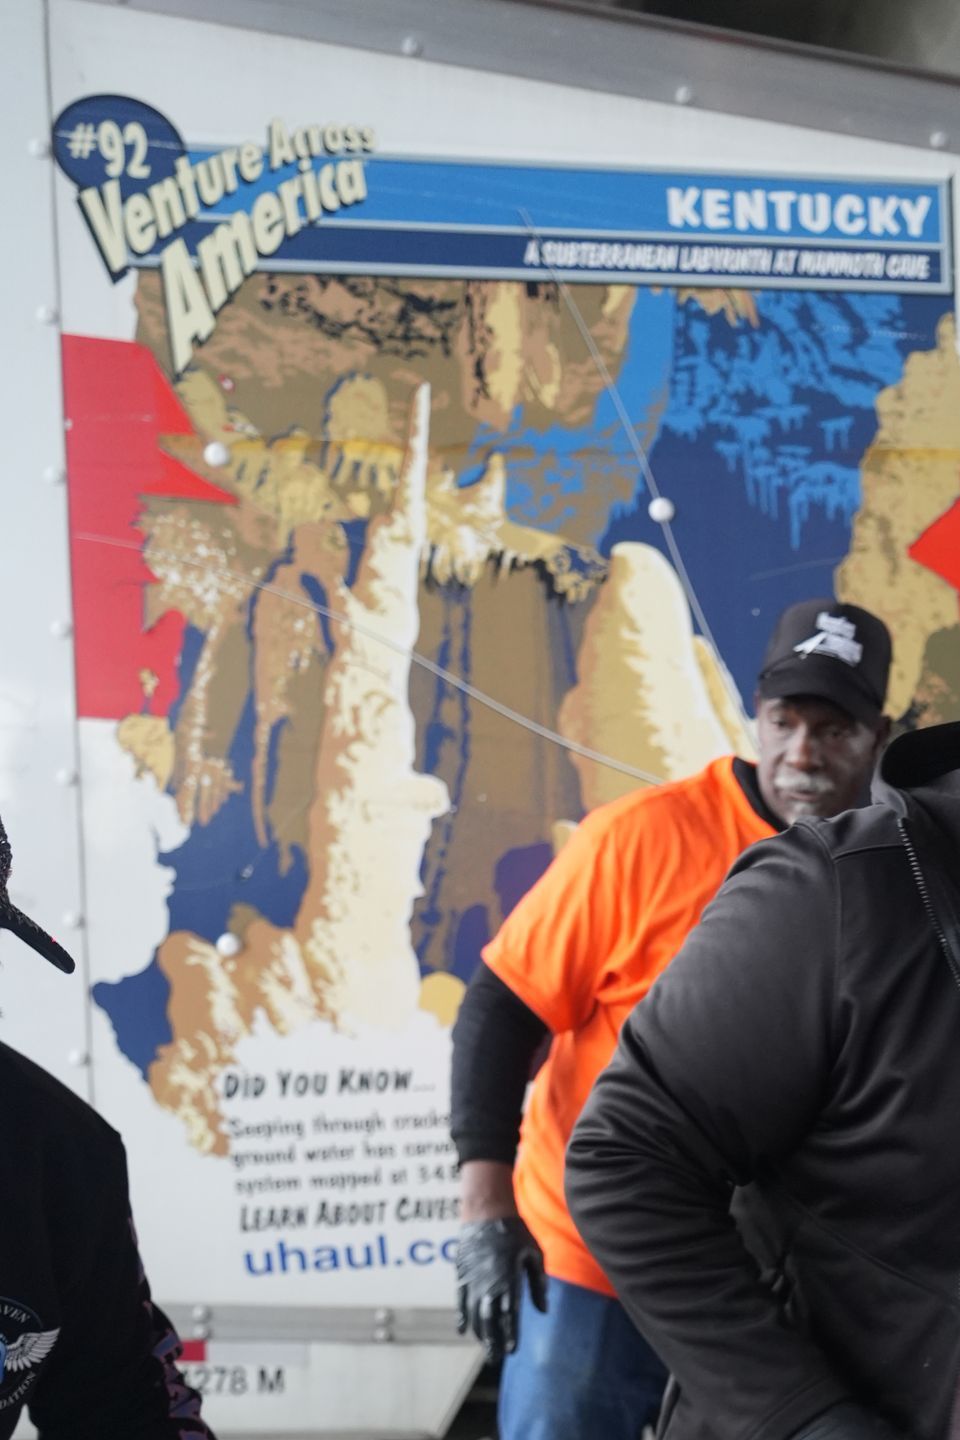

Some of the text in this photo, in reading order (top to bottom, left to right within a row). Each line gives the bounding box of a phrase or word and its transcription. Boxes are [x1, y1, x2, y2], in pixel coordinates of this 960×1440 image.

[67, 119, 151, 179] #92
[80, 117, 376, 273] Venture Across
[666, 186, 931, 237] KENTUCKY
[161, 157, 368, 373] America
[524, 240, 540, 266] A
[277, 1069, 327, 1098] YOU
[313, 1112, 384, 1133] through
[232, 1145, 296, 1168] ground
[305, 1144, 354, 1162] water
[235, 1174, 300, 1195] system
[309, 1166, 382, 1189] mapped
[240, 1202, 308, 1232] LEARN
[314, 1199, 387, 1227] ABOUT
[243, 1233, 461, 1277] uhaul.co
[184, 1364, 284, 1396] 278 M
